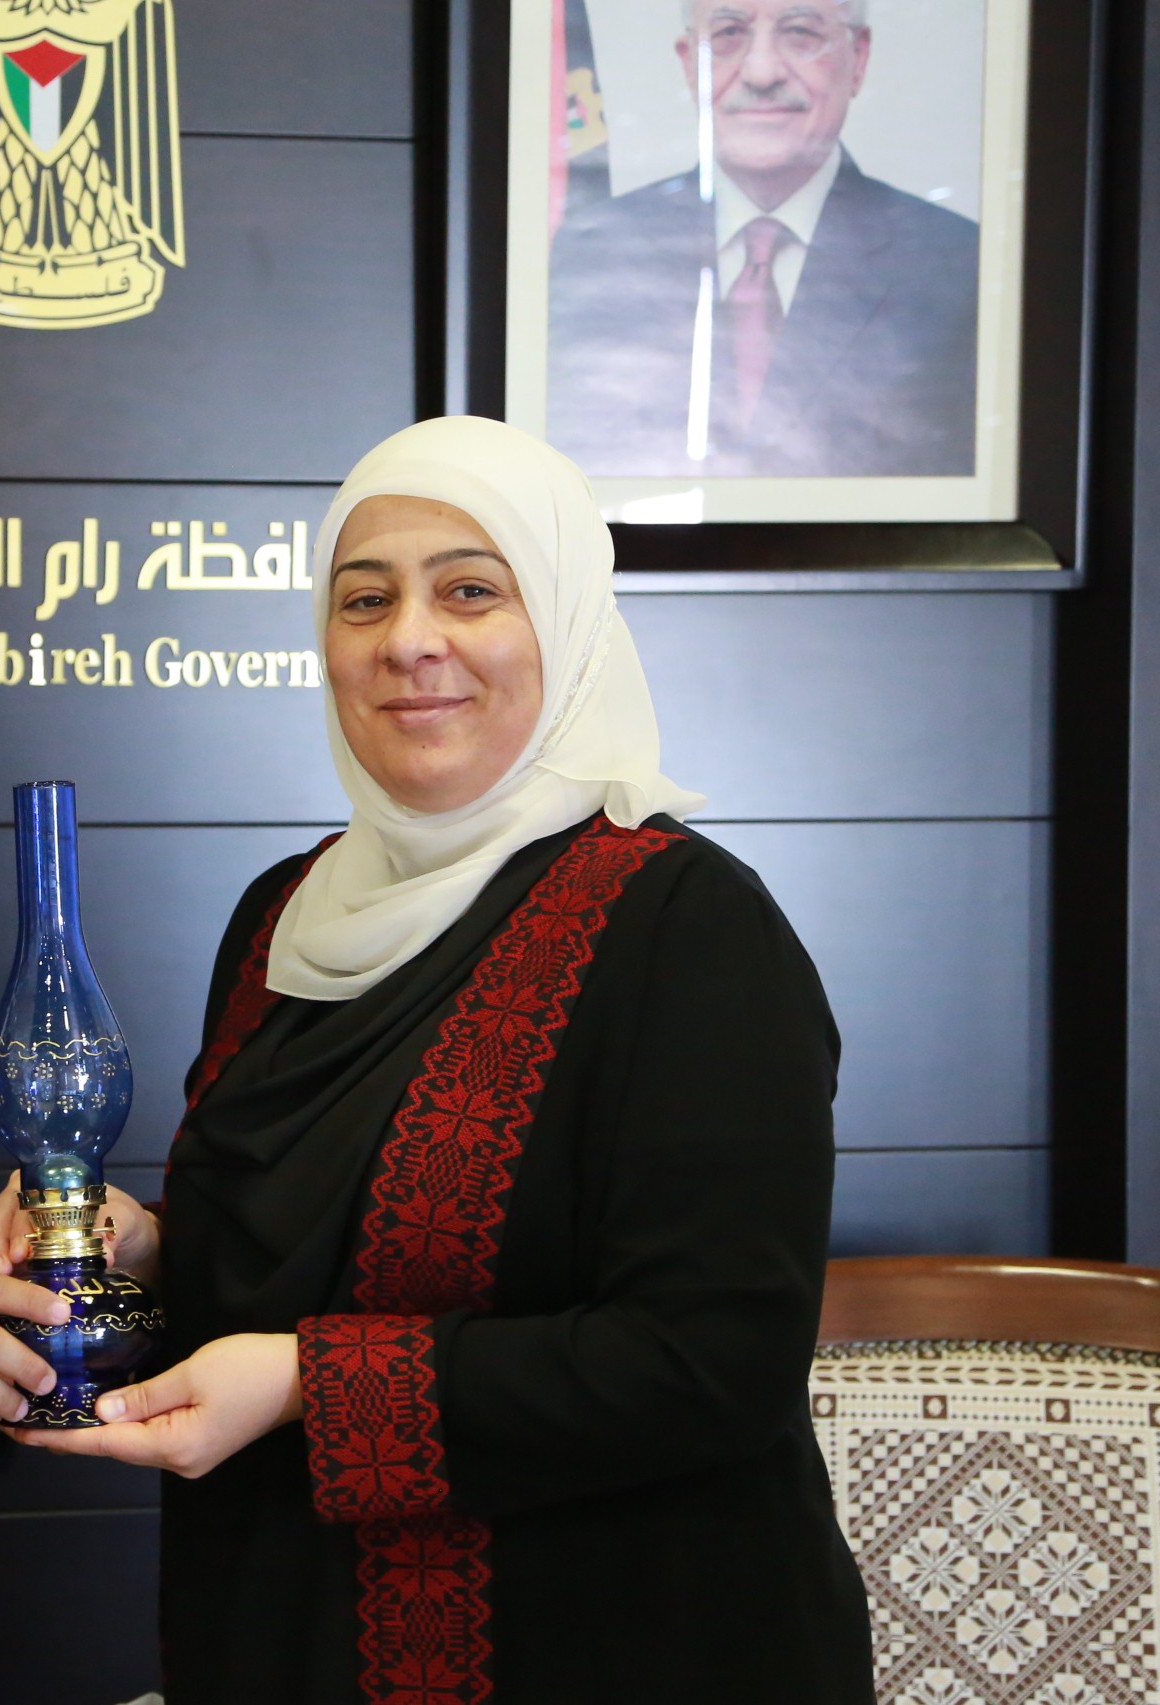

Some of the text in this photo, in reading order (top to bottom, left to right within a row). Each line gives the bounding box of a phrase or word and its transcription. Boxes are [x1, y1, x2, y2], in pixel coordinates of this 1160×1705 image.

[35, 517, 120, 621] رام
[137, 520, 314, 591] افظة
[144, 636, 325, 688] Govern
